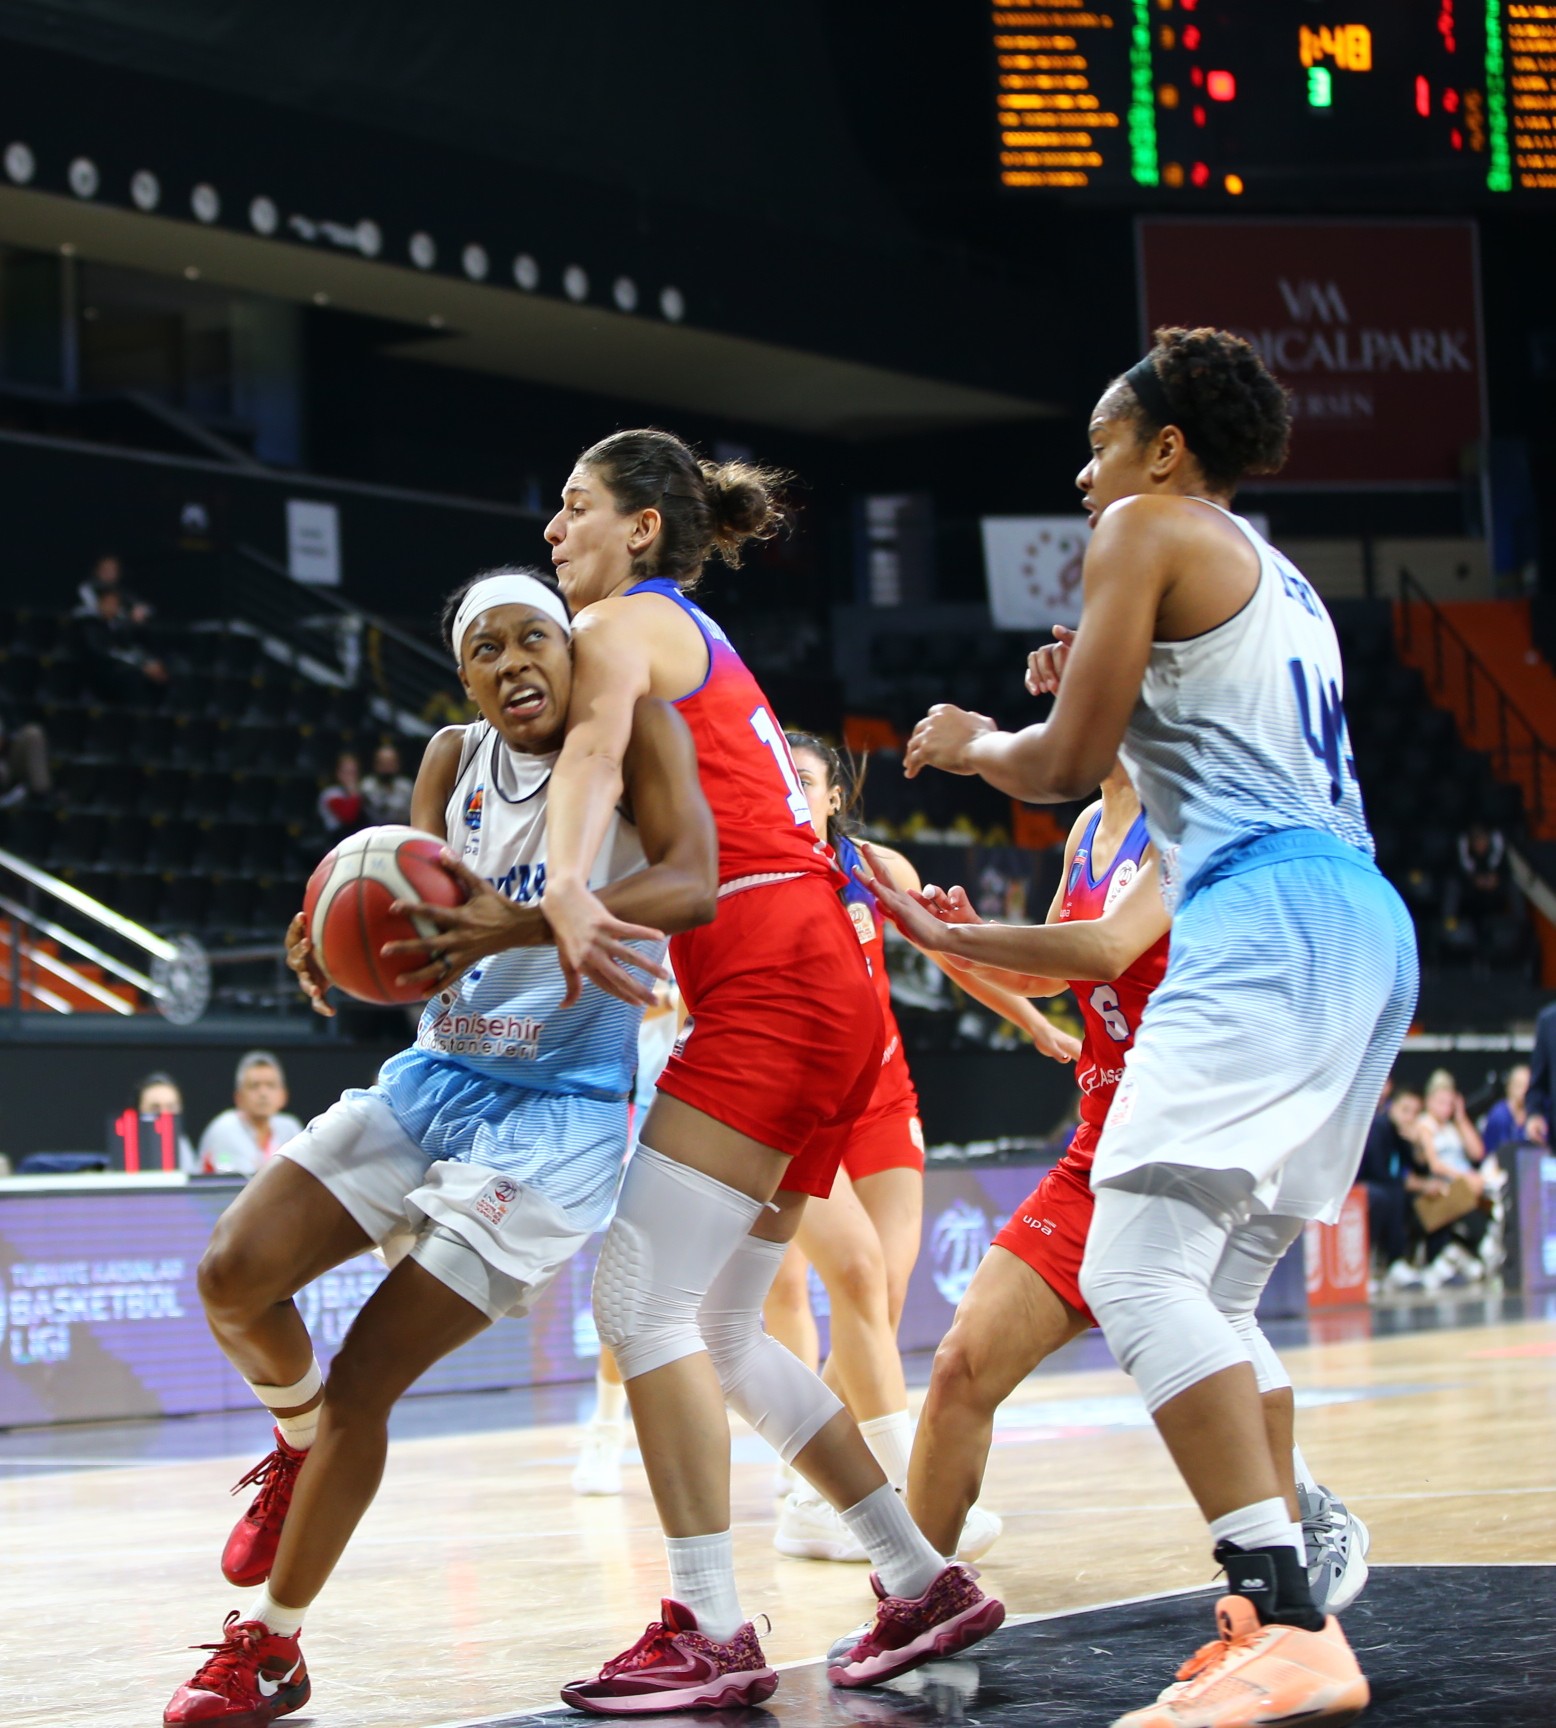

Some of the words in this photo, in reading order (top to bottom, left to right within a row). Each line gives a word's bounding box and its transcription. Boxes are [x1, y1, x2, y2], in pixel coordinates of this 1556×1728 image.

[1088, 983, 1131, 1043] 6
[1099, 1067, 1125, 1088] Asa
[1022, 1214, 1053, 1237] upa
[9, 1285, 185, 1326] BASKETBOL
